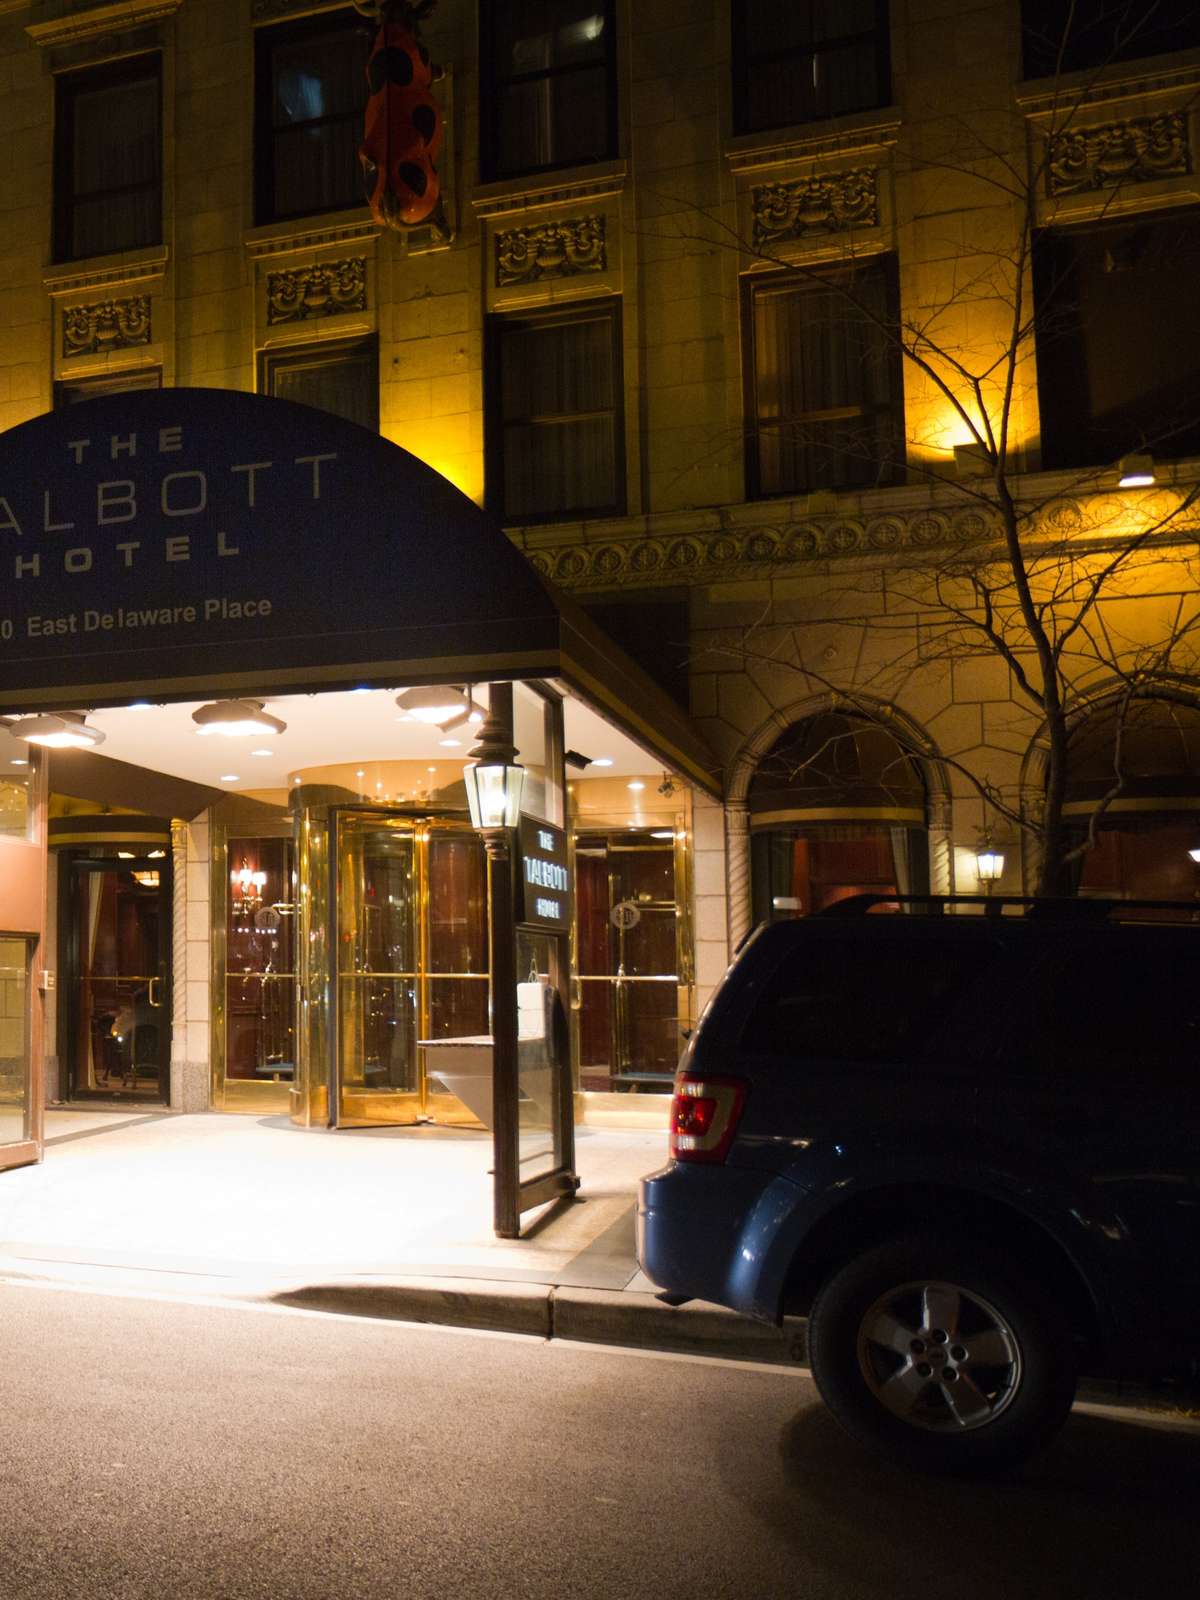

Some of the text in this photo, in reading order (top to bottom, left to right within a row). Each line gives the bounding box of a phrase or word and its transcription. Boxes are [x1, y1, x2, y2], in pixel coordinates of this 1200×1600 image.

[68, 426, 183, 465] THE
[14, 532, 240, 579] HOTEL
[27, 613, 77, 637] East
[84, 605, 197, 631] Delaware
[205, 598, 272, 620] Place
